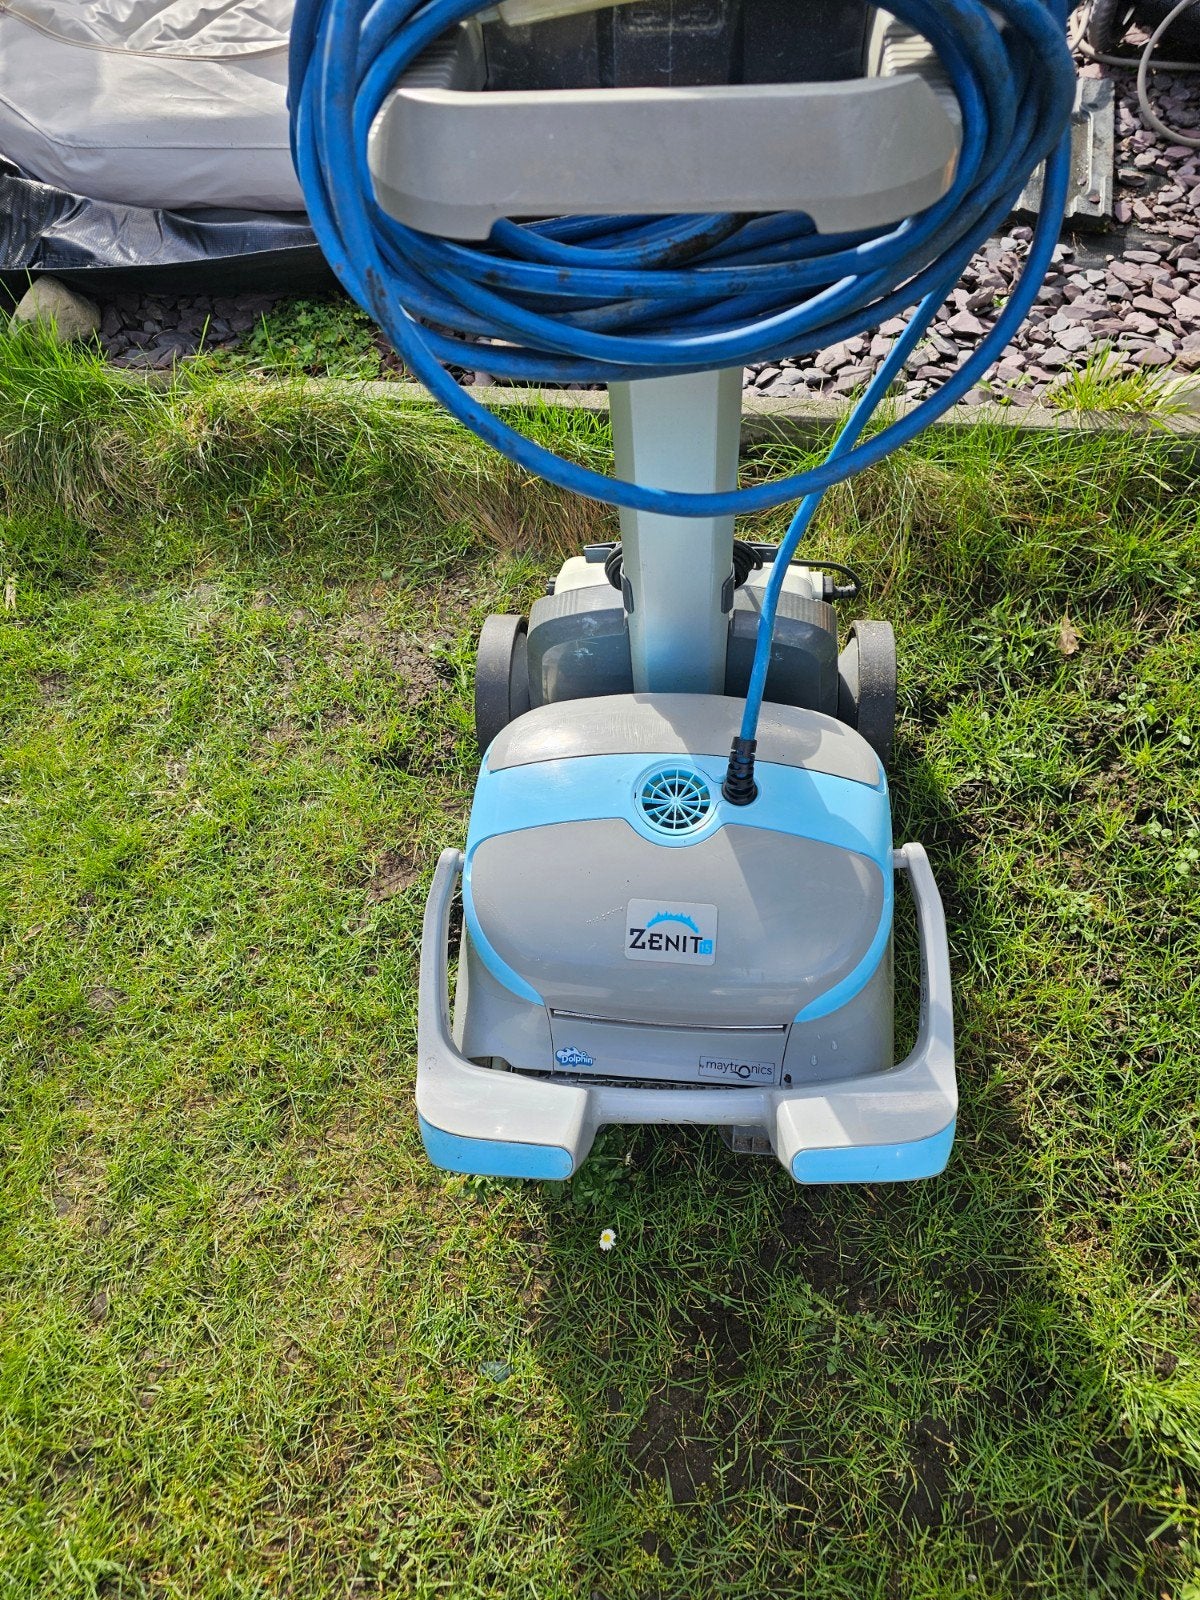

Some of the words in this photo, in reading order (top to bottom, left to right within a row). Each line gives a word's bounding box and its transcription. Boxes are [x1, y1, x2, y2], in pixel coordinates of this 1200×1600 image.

[629, 928, 703, 954] ZENIT
[561, 1055, 593, 1064] Dolphin
[706, 1061, 772, 1079] maytronics
